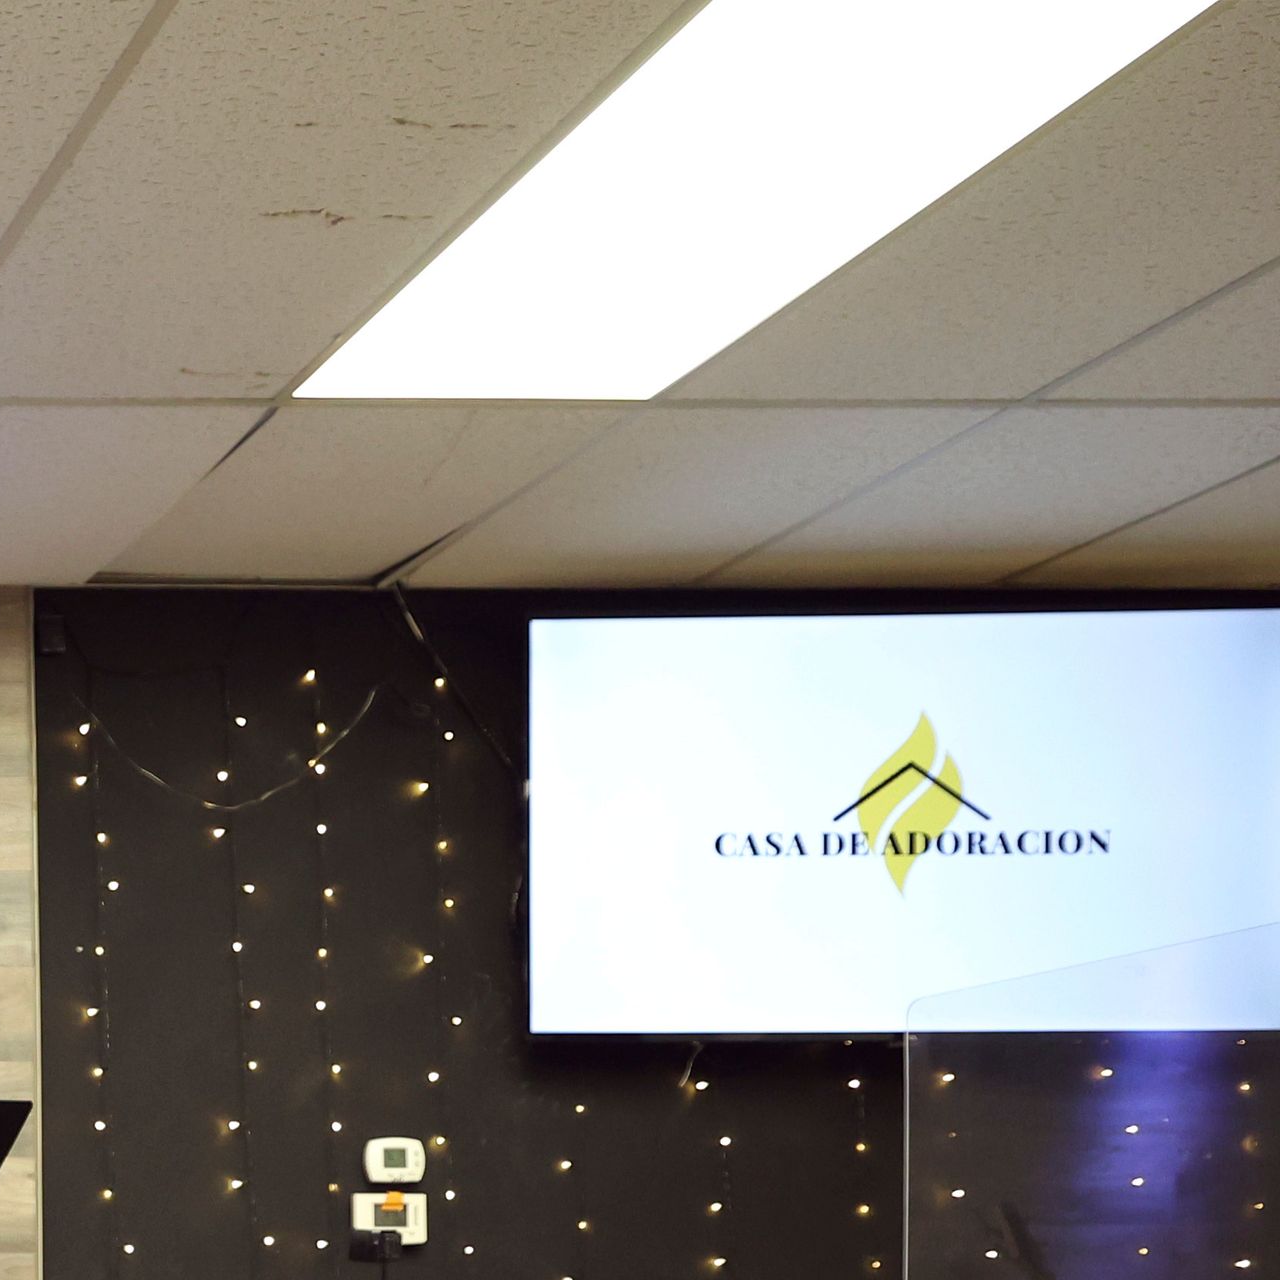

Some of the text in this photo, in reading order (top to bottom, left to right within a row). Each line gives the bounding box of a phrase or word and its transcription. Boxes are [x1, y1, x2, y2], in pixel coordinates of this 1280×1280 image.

[714, 829, 1111, 857] CASA DE ADORACION
